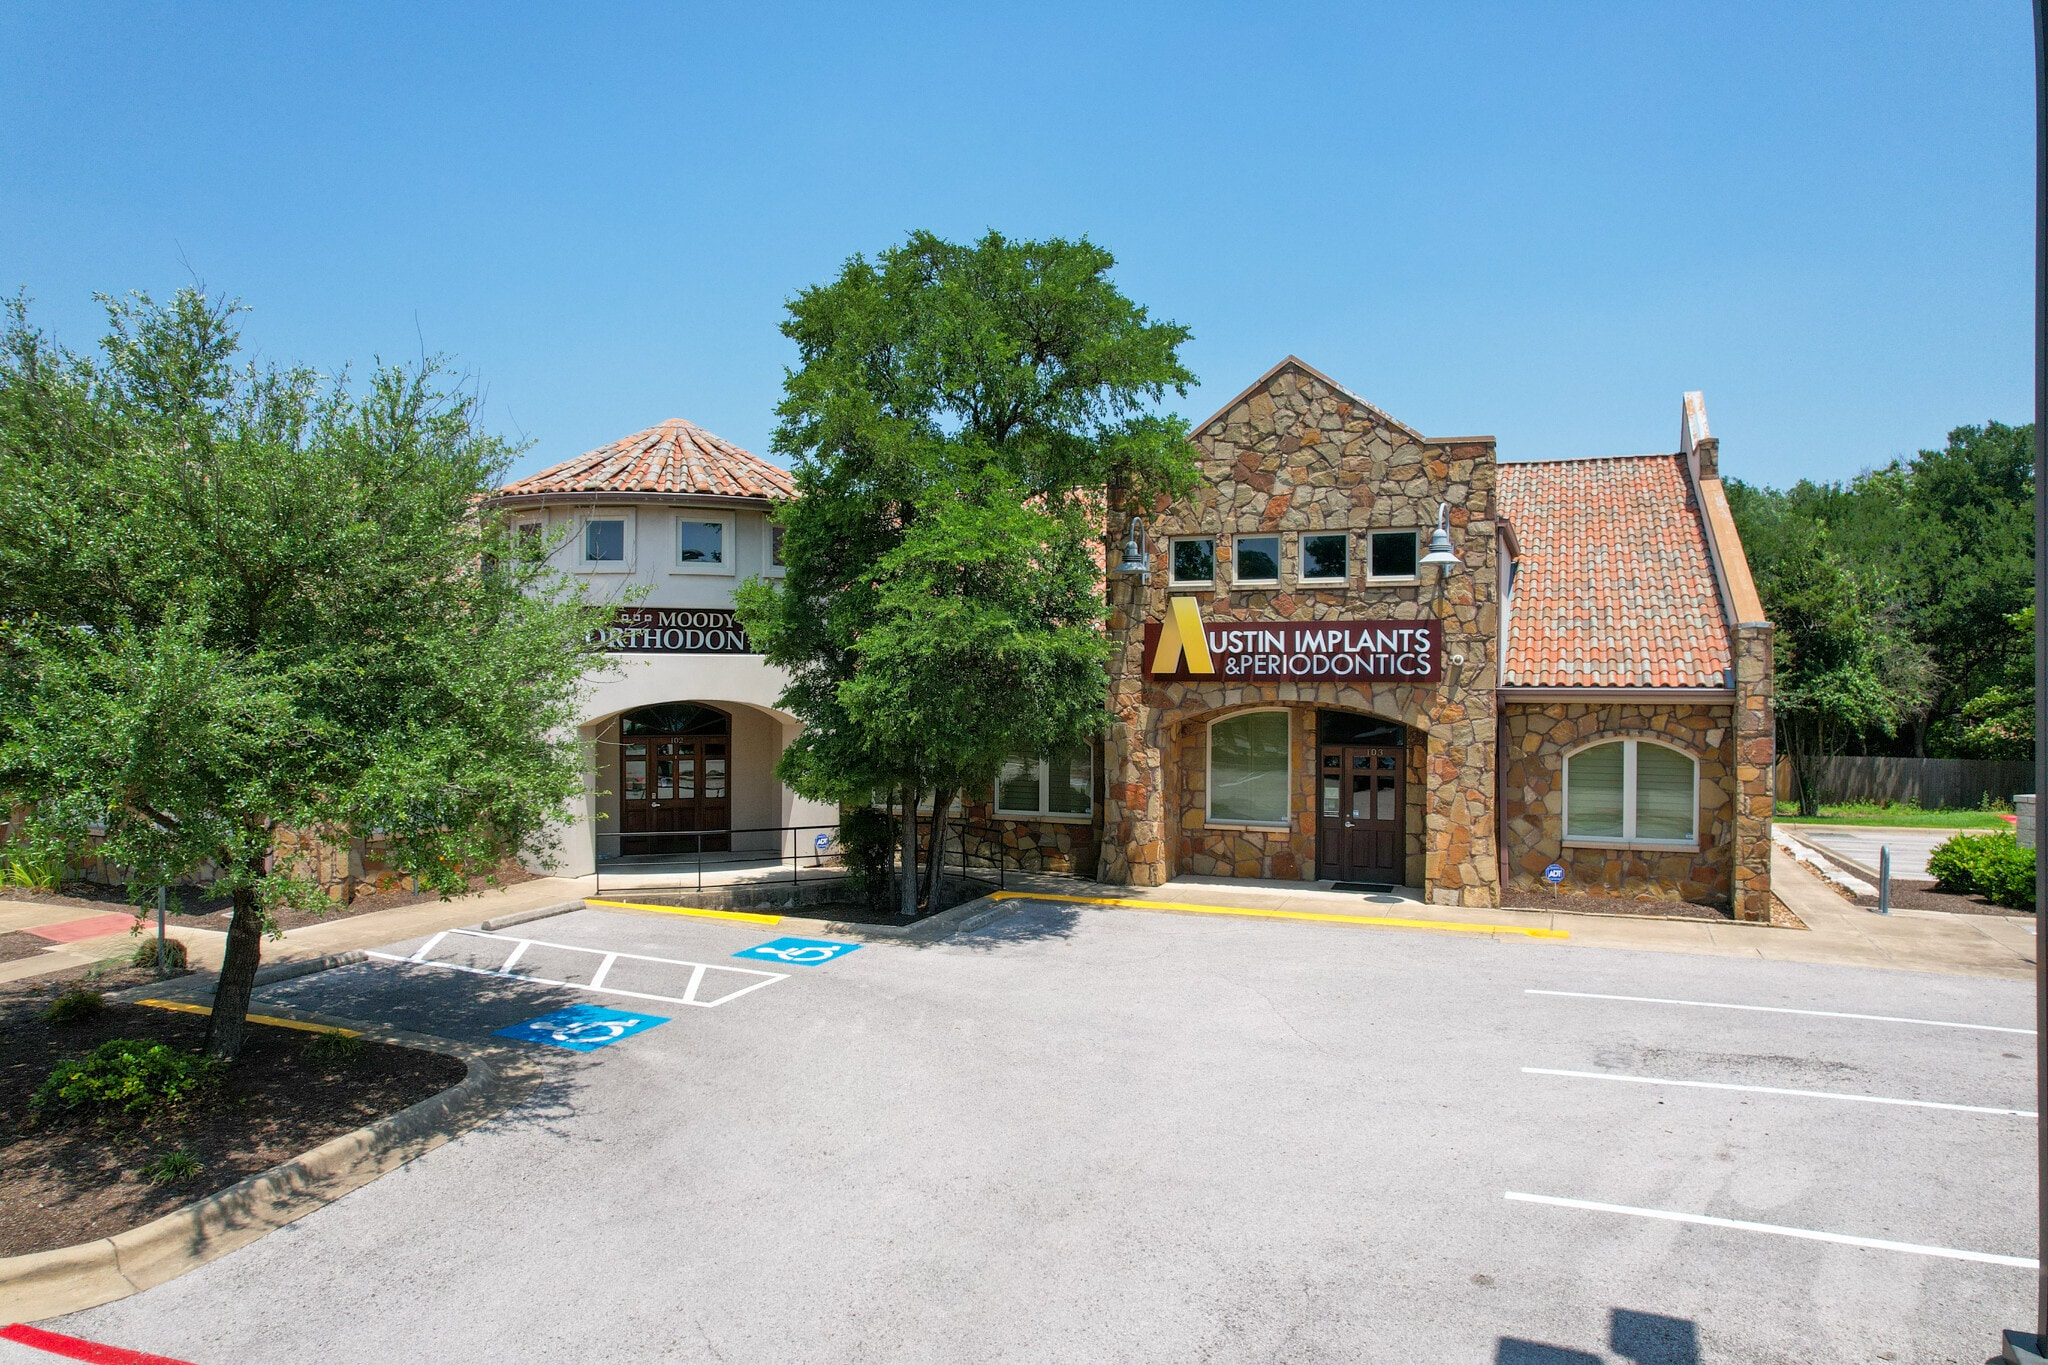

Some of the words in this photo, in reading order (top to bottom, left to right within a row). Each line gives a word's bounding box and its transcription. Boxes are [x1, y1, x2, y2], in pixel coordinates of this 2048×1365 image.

[658, 611, 735, 628] MOODY
[585, 627, 749, 651] ORTHODON
[1151, 596, 1285, 674] AUSTIN
[1295, 629, 1431, 653] IMPLANTS
[1225, 653, 1431, 675] &PERIODONTICS
[1367, 748, 1384, 756] 103
[1548, 869, 1562, 877] ADT
